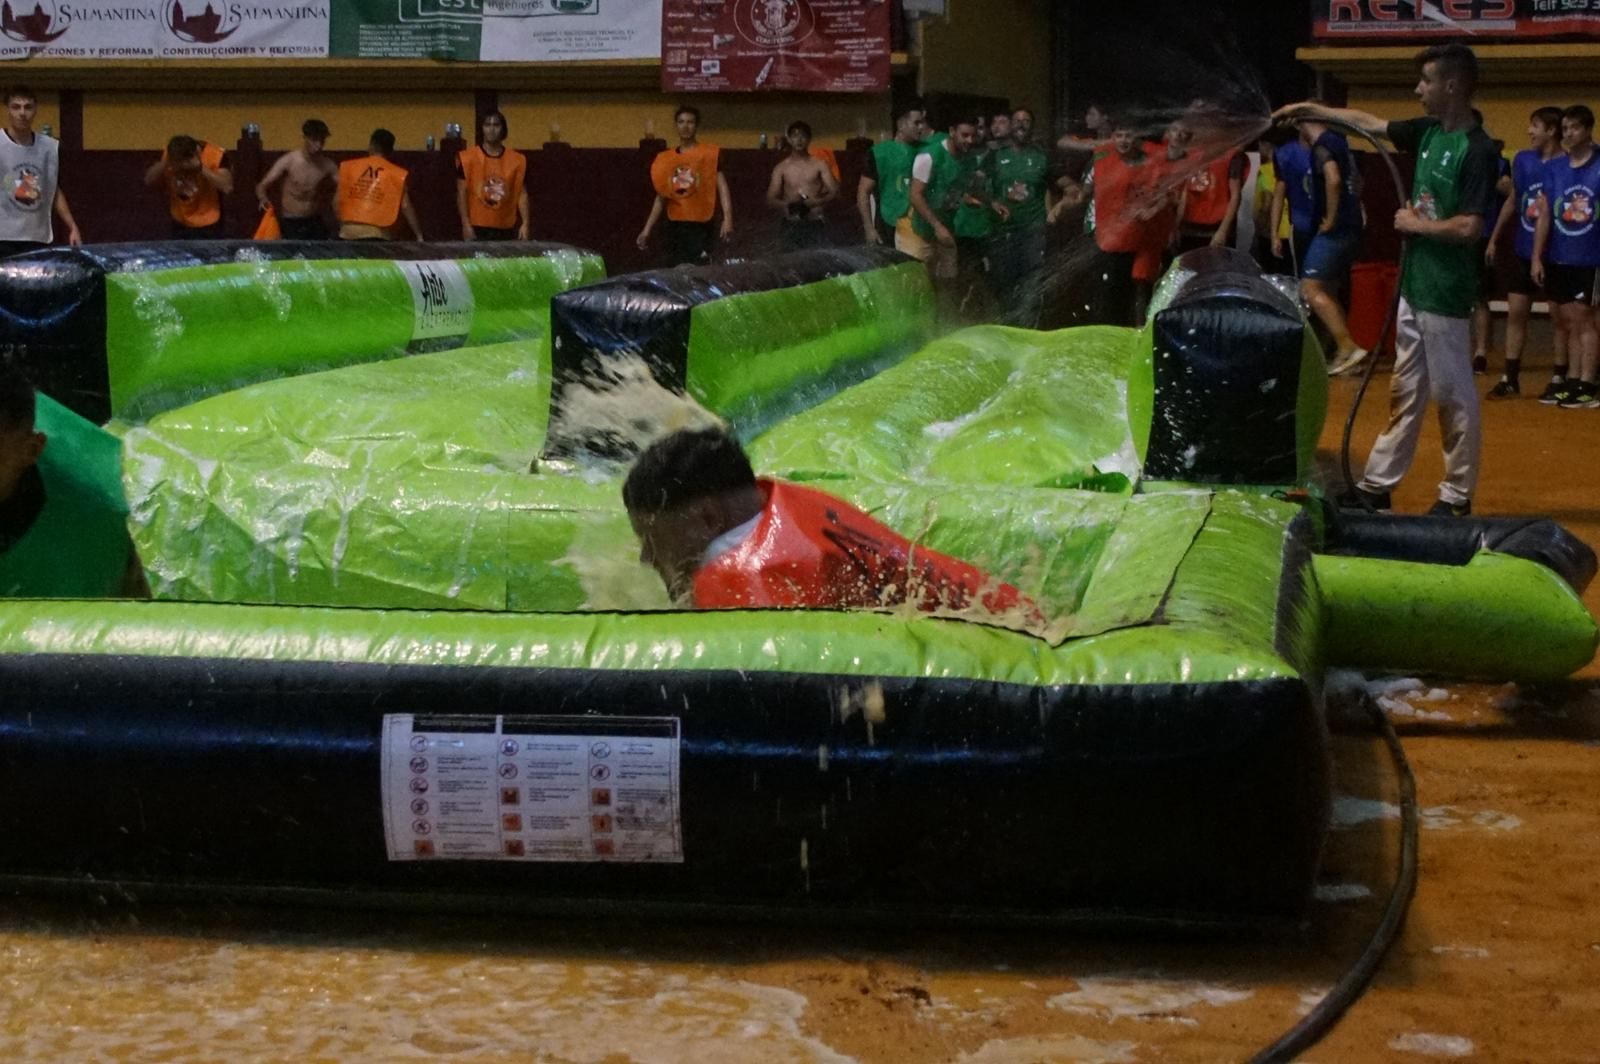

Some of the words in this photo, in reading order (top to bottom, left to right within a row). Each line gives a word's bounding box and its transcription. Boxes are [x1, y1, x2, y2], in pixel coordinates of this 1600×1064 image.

[1, 46, 86, 56] ONSTRUCCIONES
[98, 48, 154, 56] REFORMAS
[162, 47, 256, 56] CONSTRUCCIONES
[259, 47, 265, 55] Y
[269, 47, 325, 56] REFORMAS
